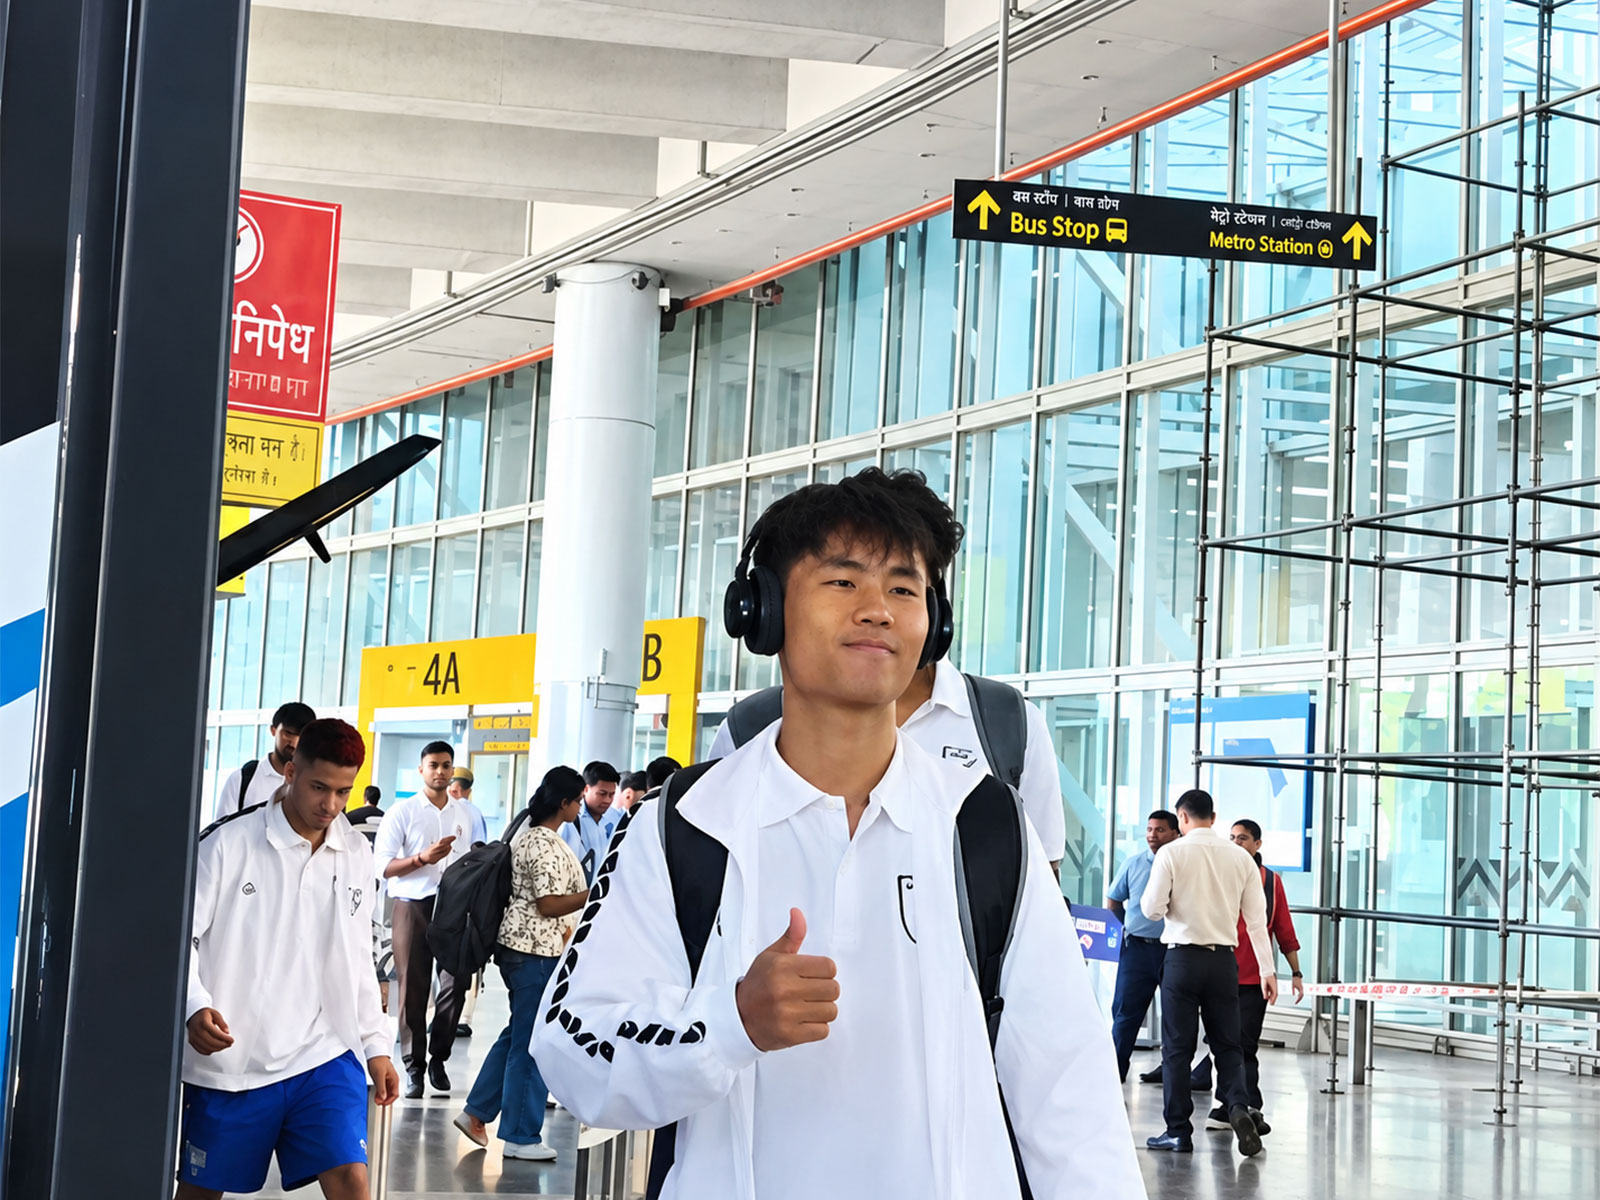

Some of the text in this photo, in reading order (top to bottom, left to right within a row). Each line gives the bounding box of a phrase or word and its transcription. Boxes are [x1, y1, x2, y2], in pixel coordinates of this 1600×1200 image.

[1010, 211, 1100, 245] Bus Stop
[1209, 231, 1314, 256] Metro Station
[423, 651, 460, 696] 4A
[642, 633, 662, 682] B
